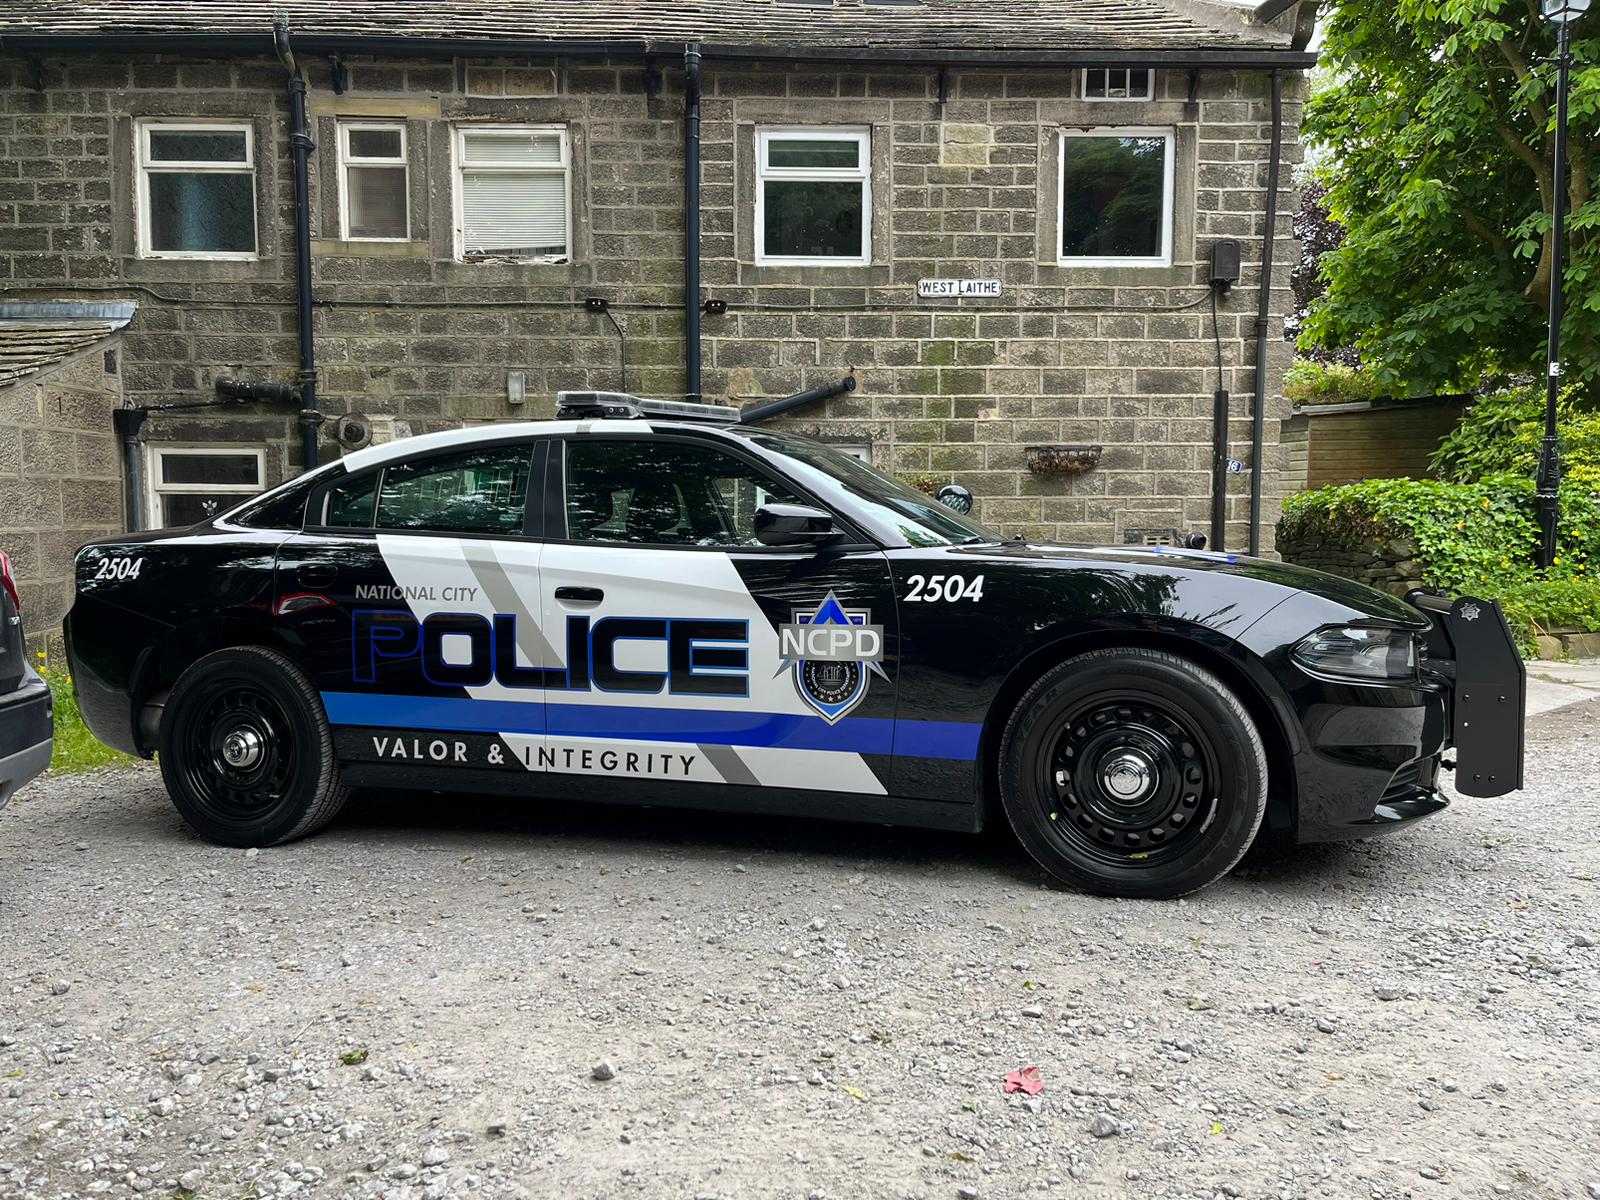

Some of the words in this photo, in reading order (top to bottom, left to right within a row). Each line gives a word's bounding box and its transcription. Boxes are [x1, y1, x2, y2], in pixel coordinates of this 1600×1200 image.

[922, 282, 954, 293] WEST
[957, 280, 997, 295] LAITHE
[94, 557, 143, 580] 2504
[355, 585, 436, 600] NATIONAL
[442, 587, 478, 601] CITY
[903, 575, 984, 602] 2504
[351, 609, 750, 698] POLICE
[782, 628, 880, 657] NCPD
[372, 737, 468, 762] VALOR
[487, 744, 504, 764] &
[525, 746, 695, 775] INTEGRITY
